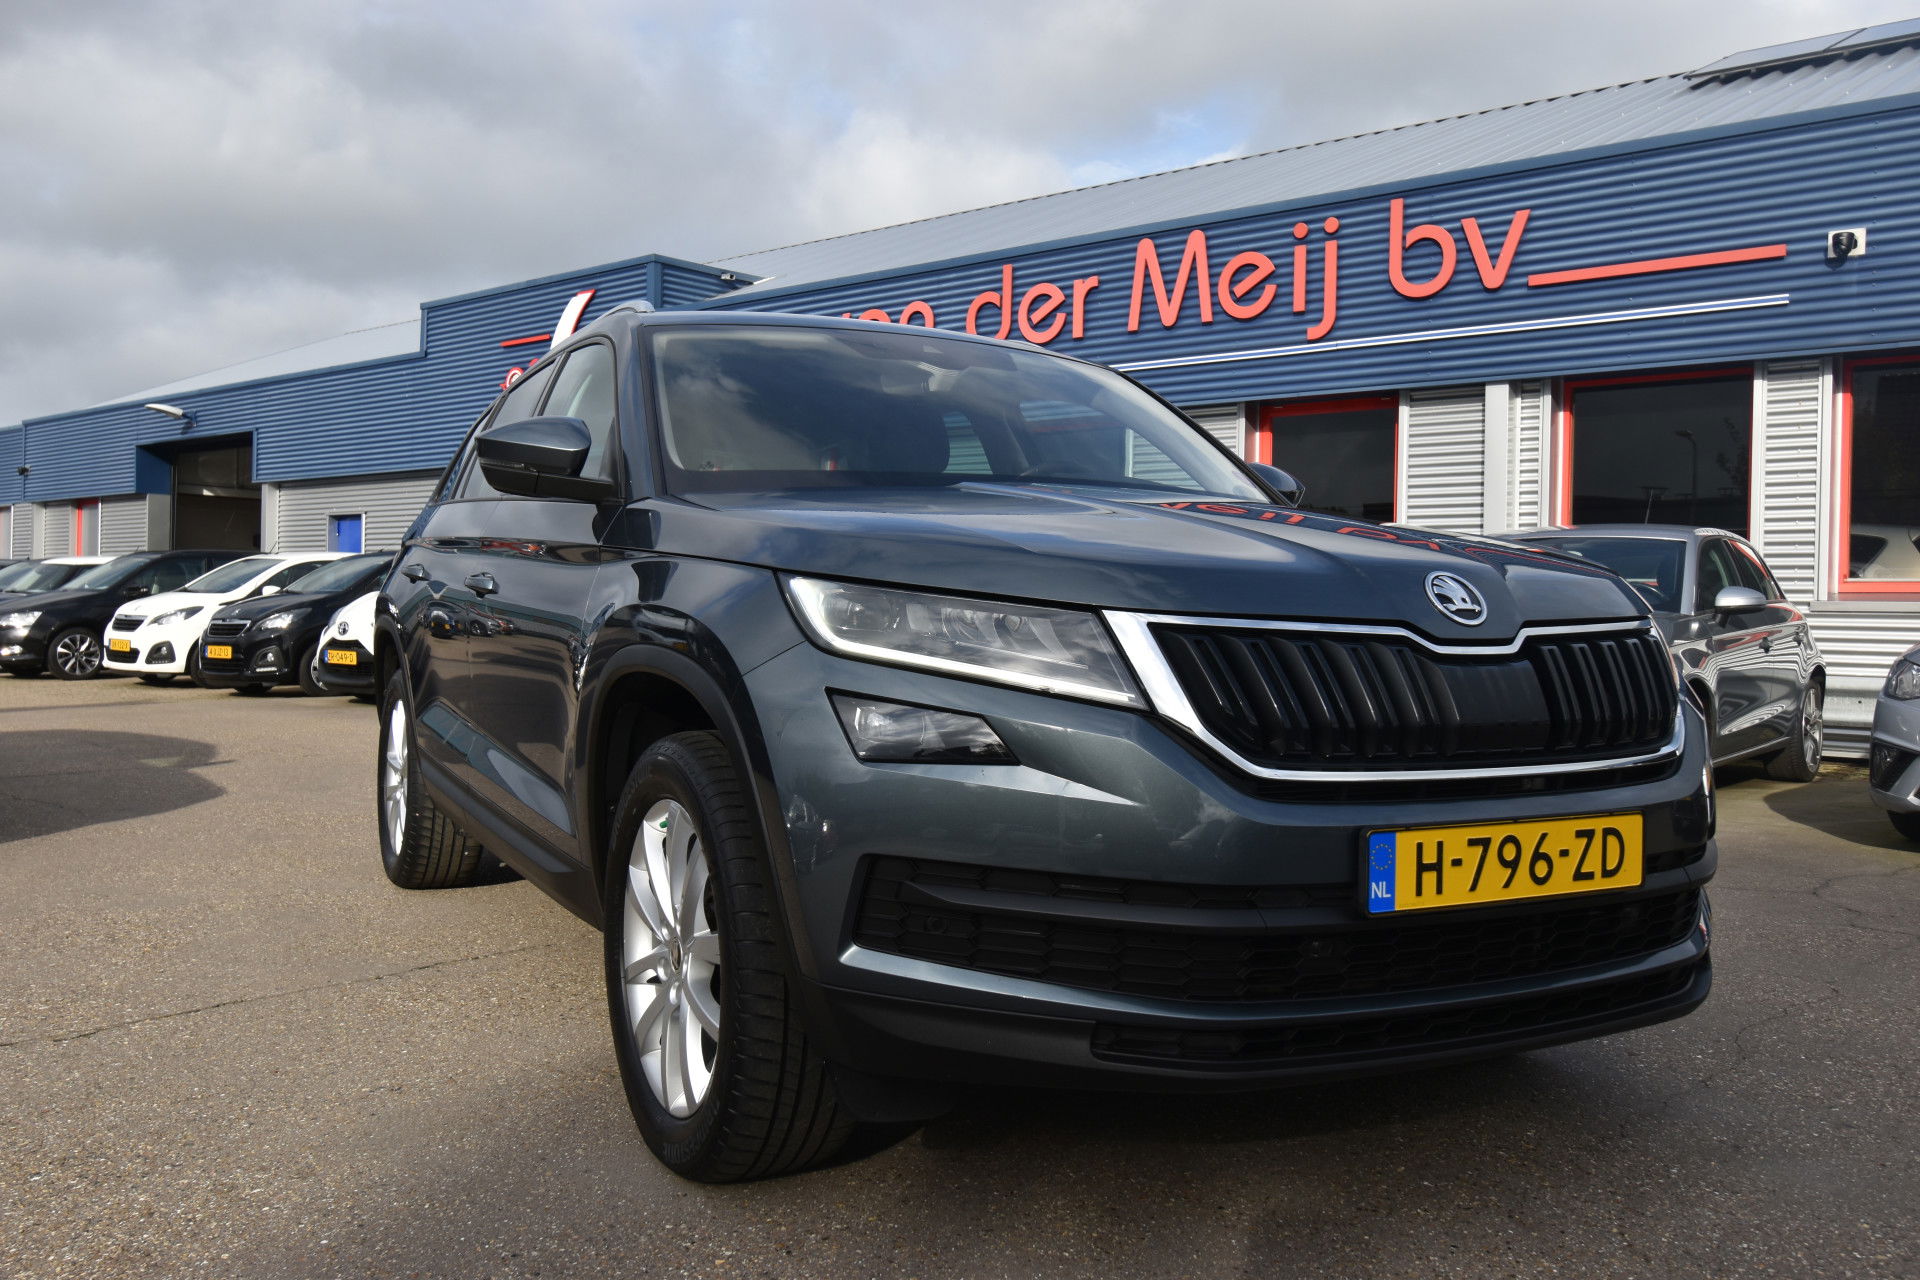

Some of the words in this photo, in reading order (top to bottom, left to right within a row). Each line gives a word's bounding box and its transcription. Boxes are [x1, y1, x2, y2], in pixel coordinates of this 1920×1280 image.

[966, 264, 1099, 344] der
[1127, 217, 1340, 341] Meij
[1388, 198, 1531, 298] bv
[1371, 881, 1391, 899] NL
[1415, 826, 1626, 897] H-796-ZD
